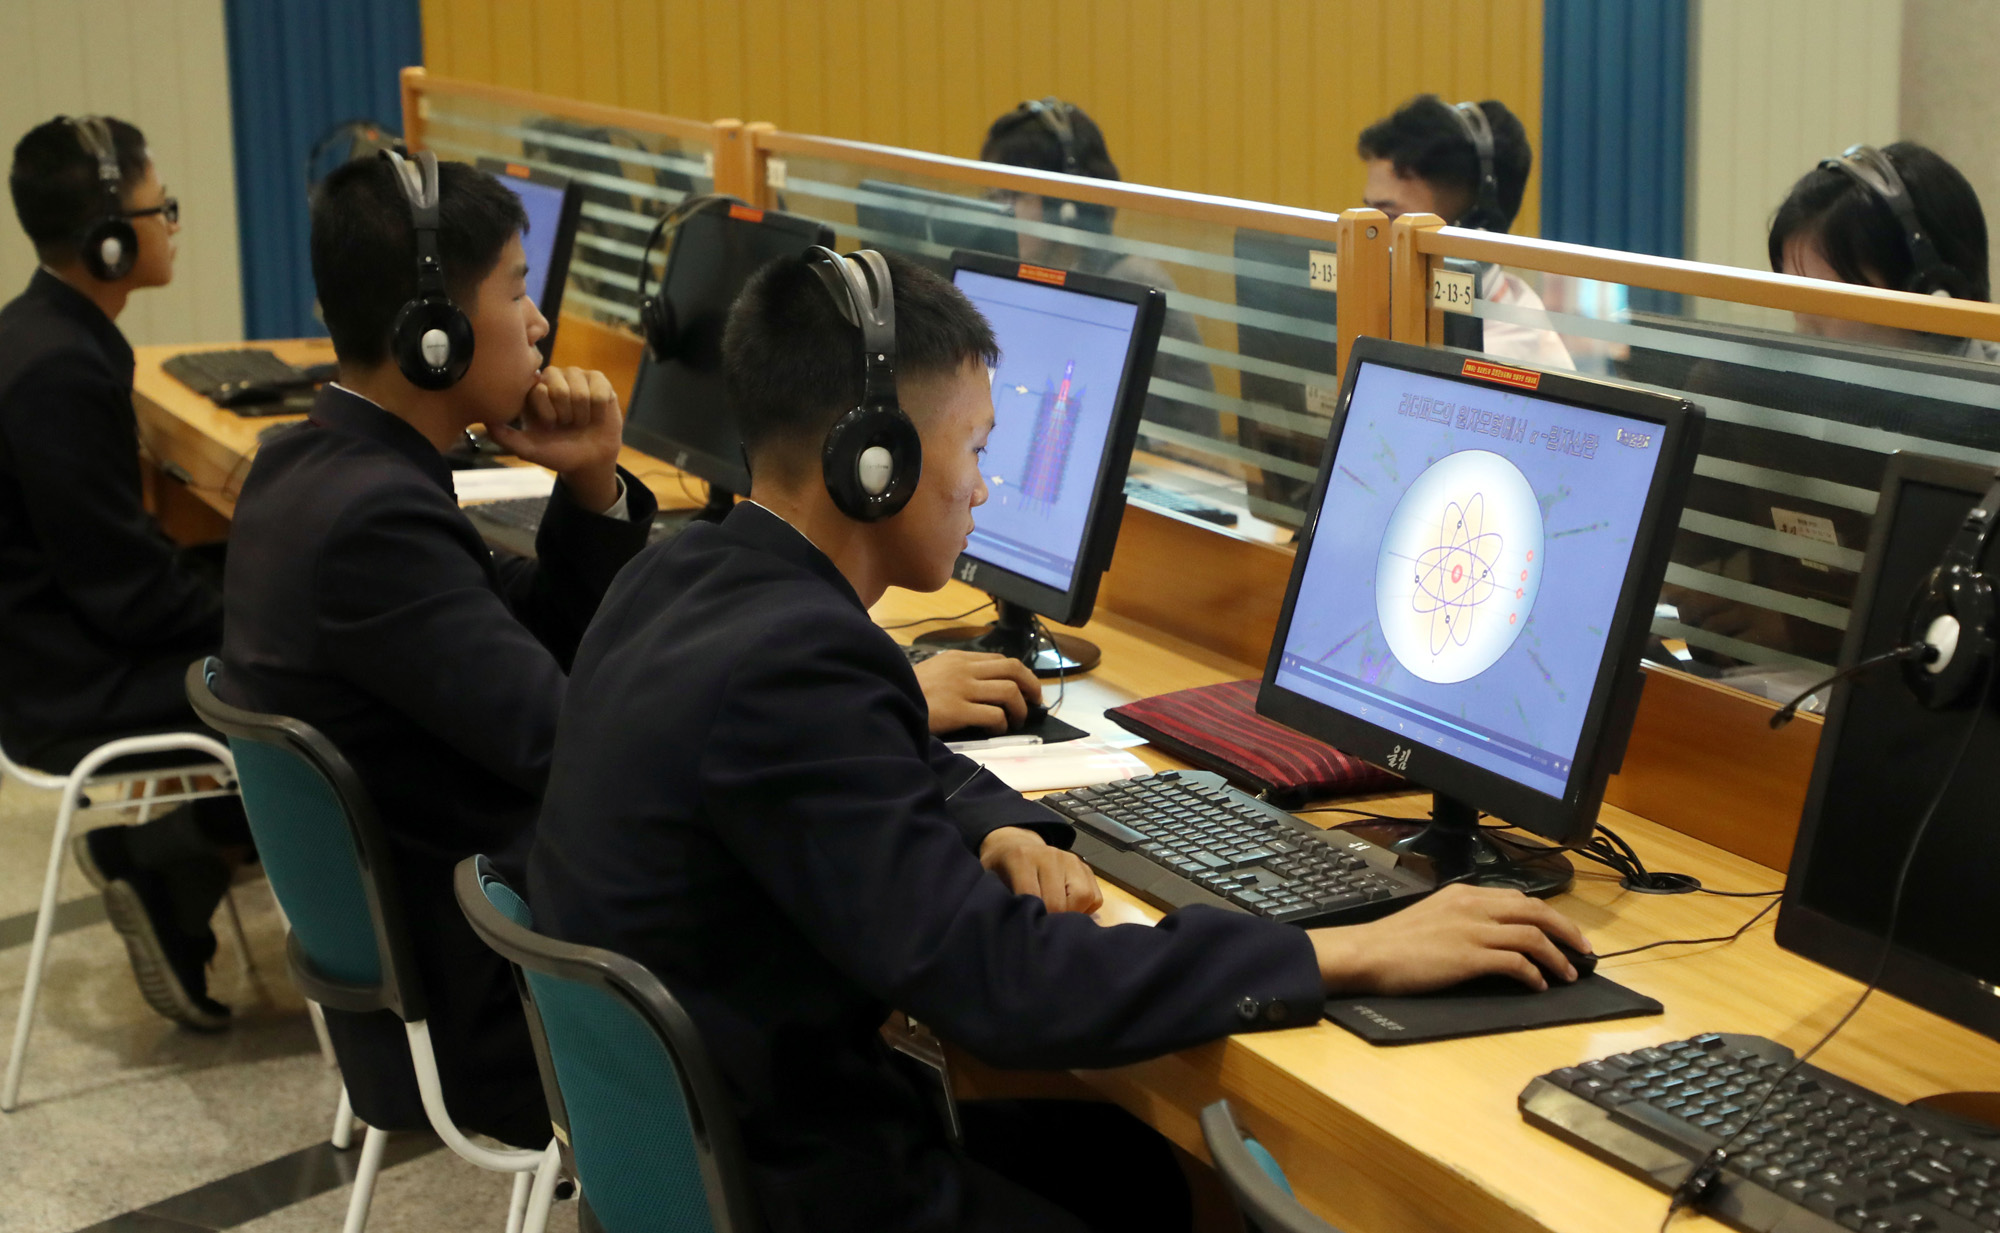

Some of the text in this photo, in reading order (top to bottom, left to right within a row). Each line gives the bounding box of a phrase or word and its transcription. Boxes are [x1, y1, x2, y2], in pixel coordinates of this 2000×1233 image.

[1311, 262, 1337, 283] 2-13-
[1434, 281, 1471, 305] 2-13-5
[1455, 405, 1529, 444] 원자모형에서
[1386, 744, 1412, 771] 울림
